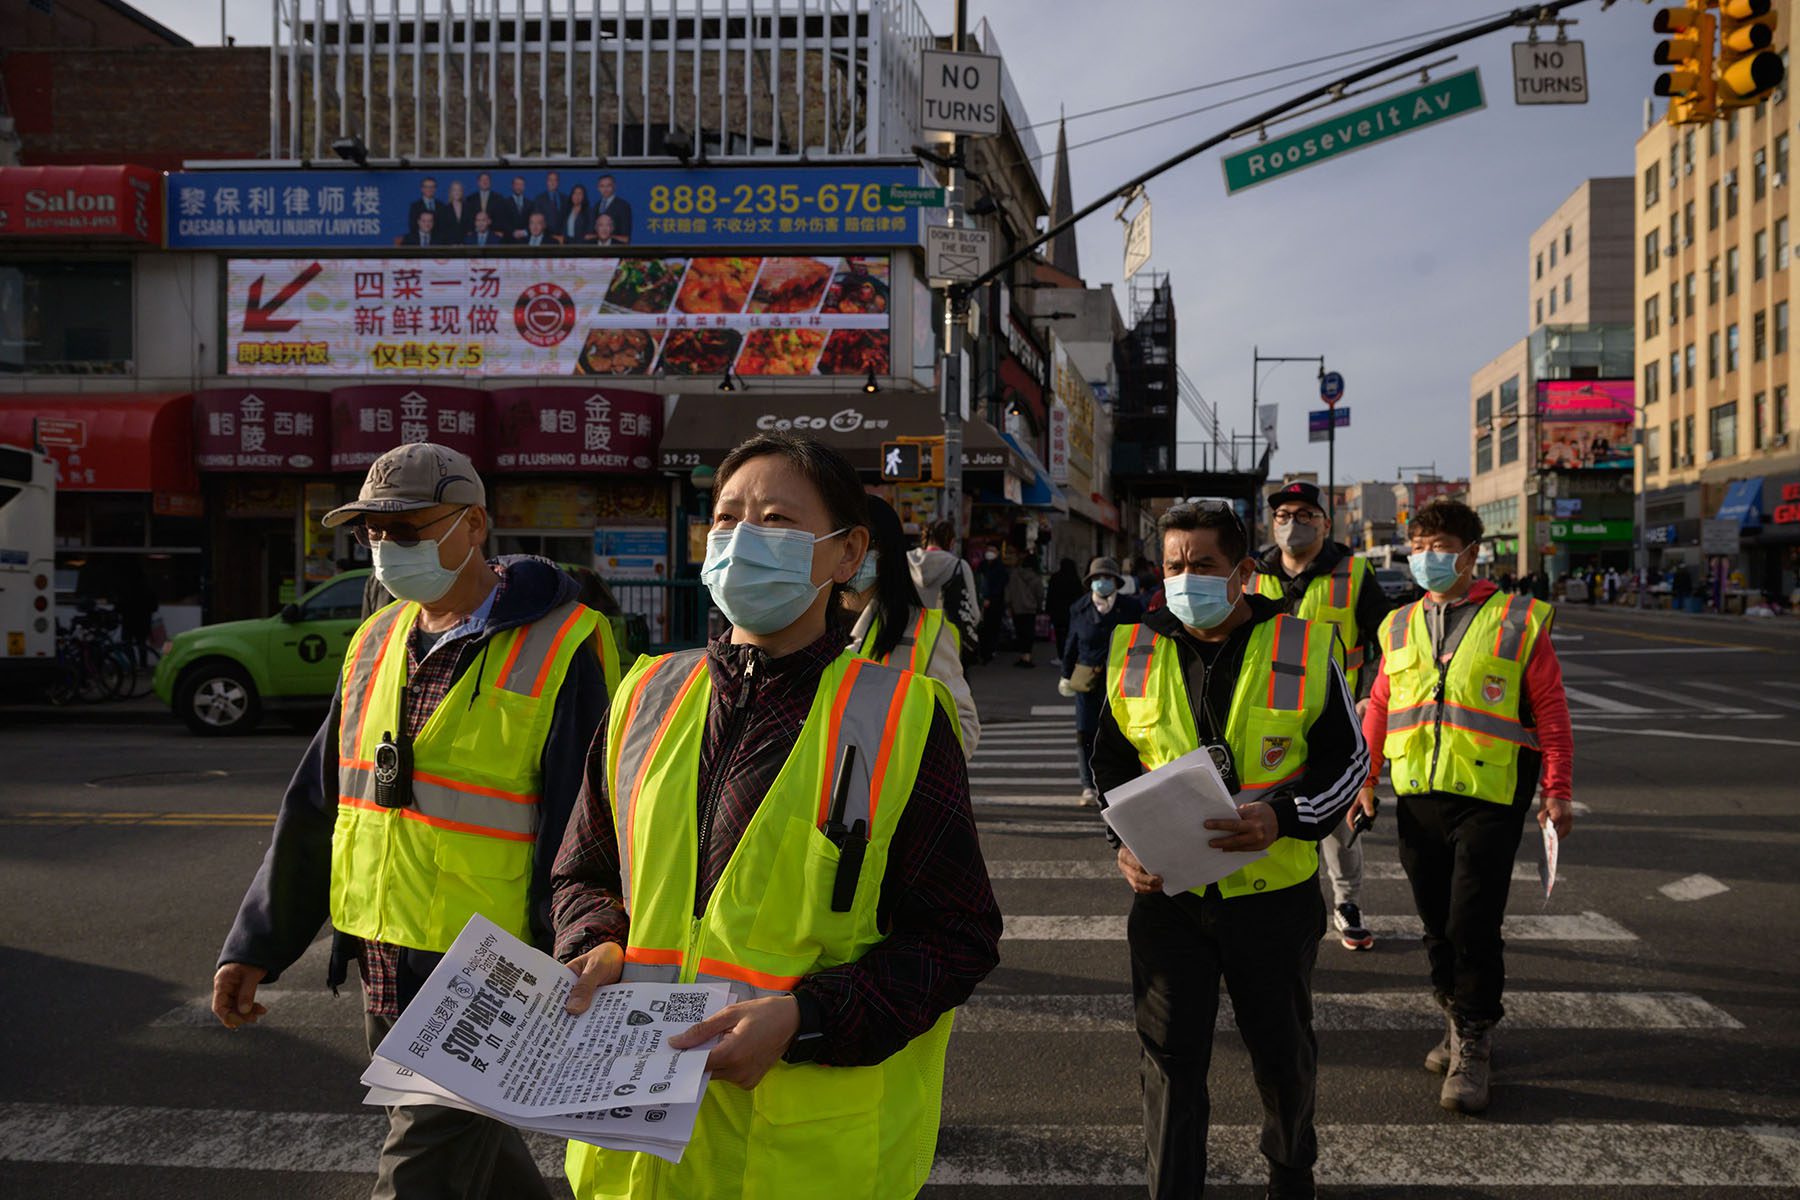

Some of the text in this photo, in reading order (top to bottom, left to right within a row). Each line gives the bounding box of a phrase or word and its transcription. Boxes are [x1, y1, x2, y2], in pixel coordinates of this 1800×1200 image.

[1533, 50, 1565, 70] NO
[942, 64, 979, 91] NO
[1518, 76, 1583, 95] TURNS
[925, 98, 996, 123] TURNS
[1248, 90, 1453, 178] Roosevelt Av
[24, 188, 116, 212] Salon
[179, 186, 380, 215] 黎保利律师楼
[179, 219, 381, 236] CAESAR & NAPOLI INJURY LAWYERS
[712, 218, 773, 234] 不收分文
[931, 230, 986, 243] DON'T BLOCK
[941, 241, 977, 254] THE BOX
[354, 268, 500, 300] 四菜一汤
[354, 304, 499, 337] 新鲜现做
[237, 342, 328, 366] 即刻开饭
[373, 343, 482, 367] 仅售$7.5
[584, 393, 612, 452] 金陵
[236, 453, 284, 467] BAKERY
[518, 453, 576, 467] FLUSHING
[580, 454, 630, 467] BAKERY
[663, 453, 700, 466] 39-22
[972, 453, 1004, 465] Juice
[461, 931, 498, 977] Public Safety
[478, 949, 498, 973] Patrol
[461, 985, 505, 1031] HATE
[511, 1030, 520, 1040] for
[515, 1017, 528, 1031] Our
[439, 1016, 486, 1064] STOP
[505, 1038, 517, 1049] Up
[495, 1046, 511, 1065] Stand
[628, 1057, 647, 1083] Public
[644, 1027, 663, 1055] Patrol
